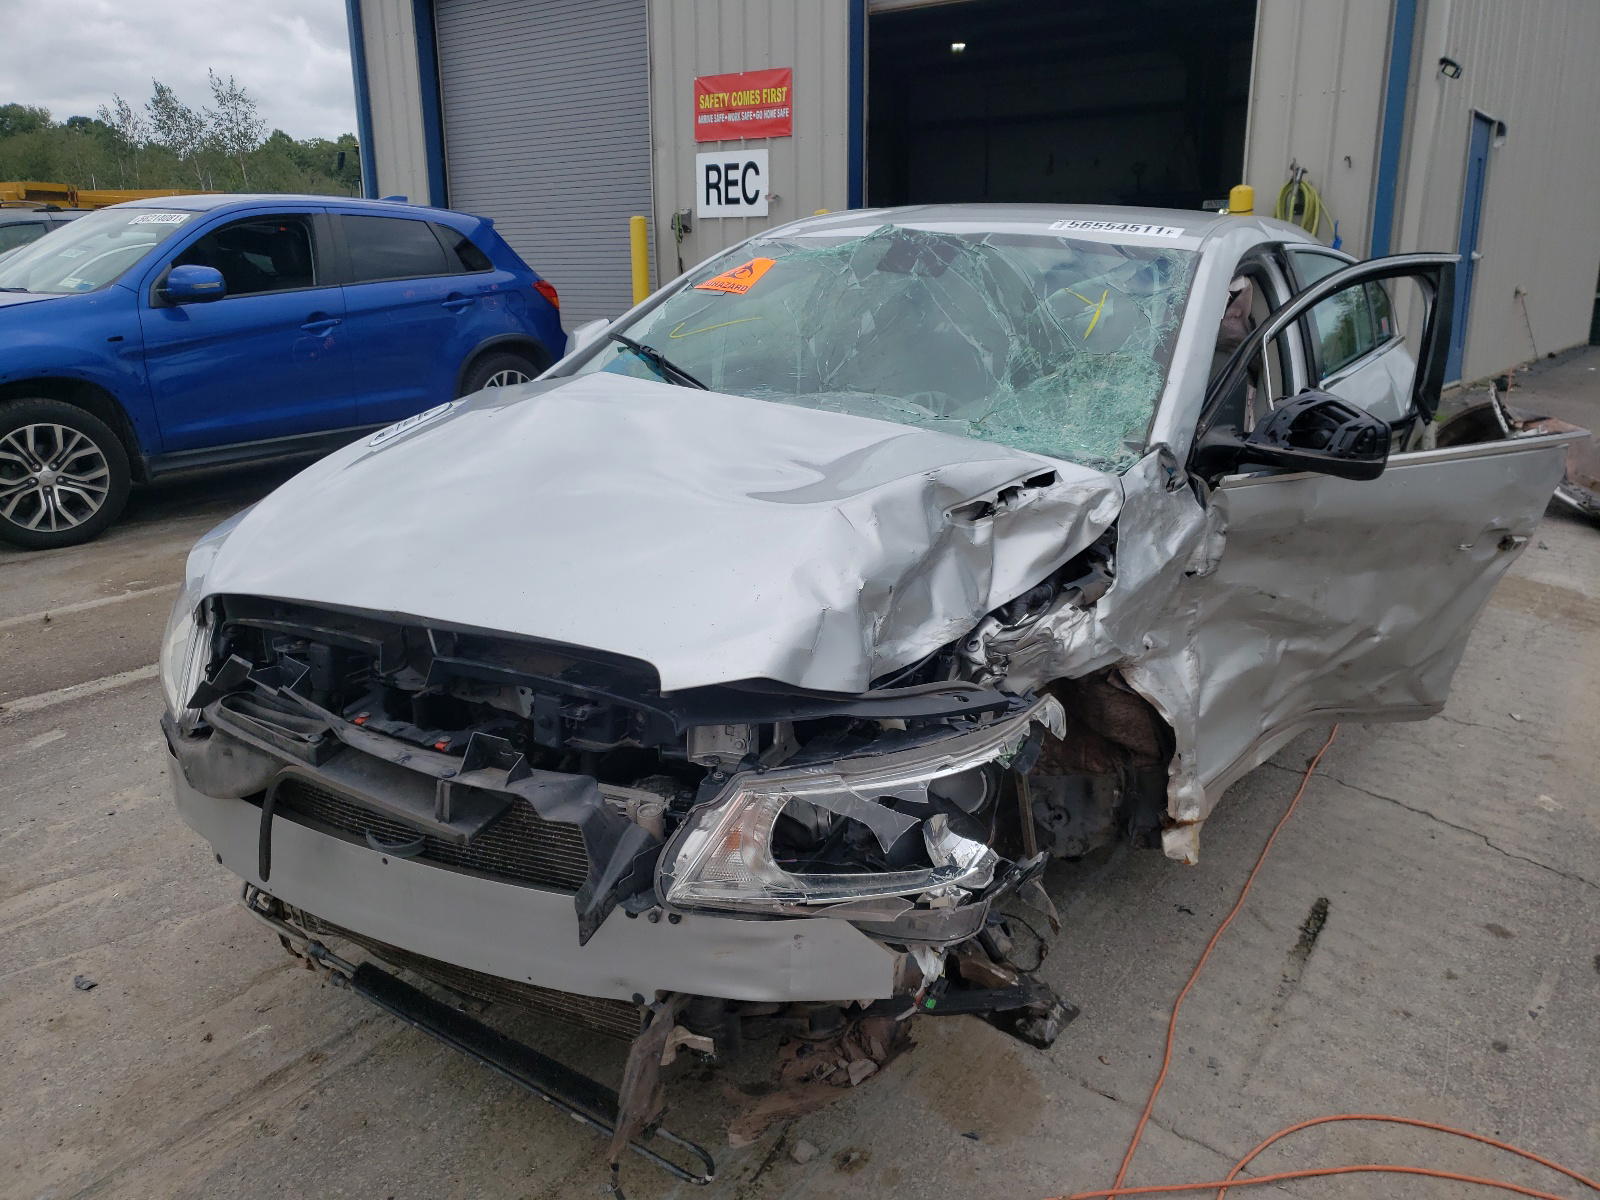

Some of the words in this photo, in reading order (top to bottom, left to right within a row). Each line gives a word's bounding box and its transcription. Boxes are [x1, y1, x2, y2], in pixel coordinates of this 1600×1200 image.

[700, 93, 730, 109] SAFETY
[731, 89, 760, 106] COMES
[762, 87, 787, 104] FIRST
[714, 113, 725, 122] SAFE
[727, 111, 741, 122] WORK
[741, 111, 753, 120] SAFE
[755, 110, 763, 119] GO
[763, 108, 776, 119] HOME
[777, 107, 789, 118] SAFE
[705, 161, 760, 206] REC
